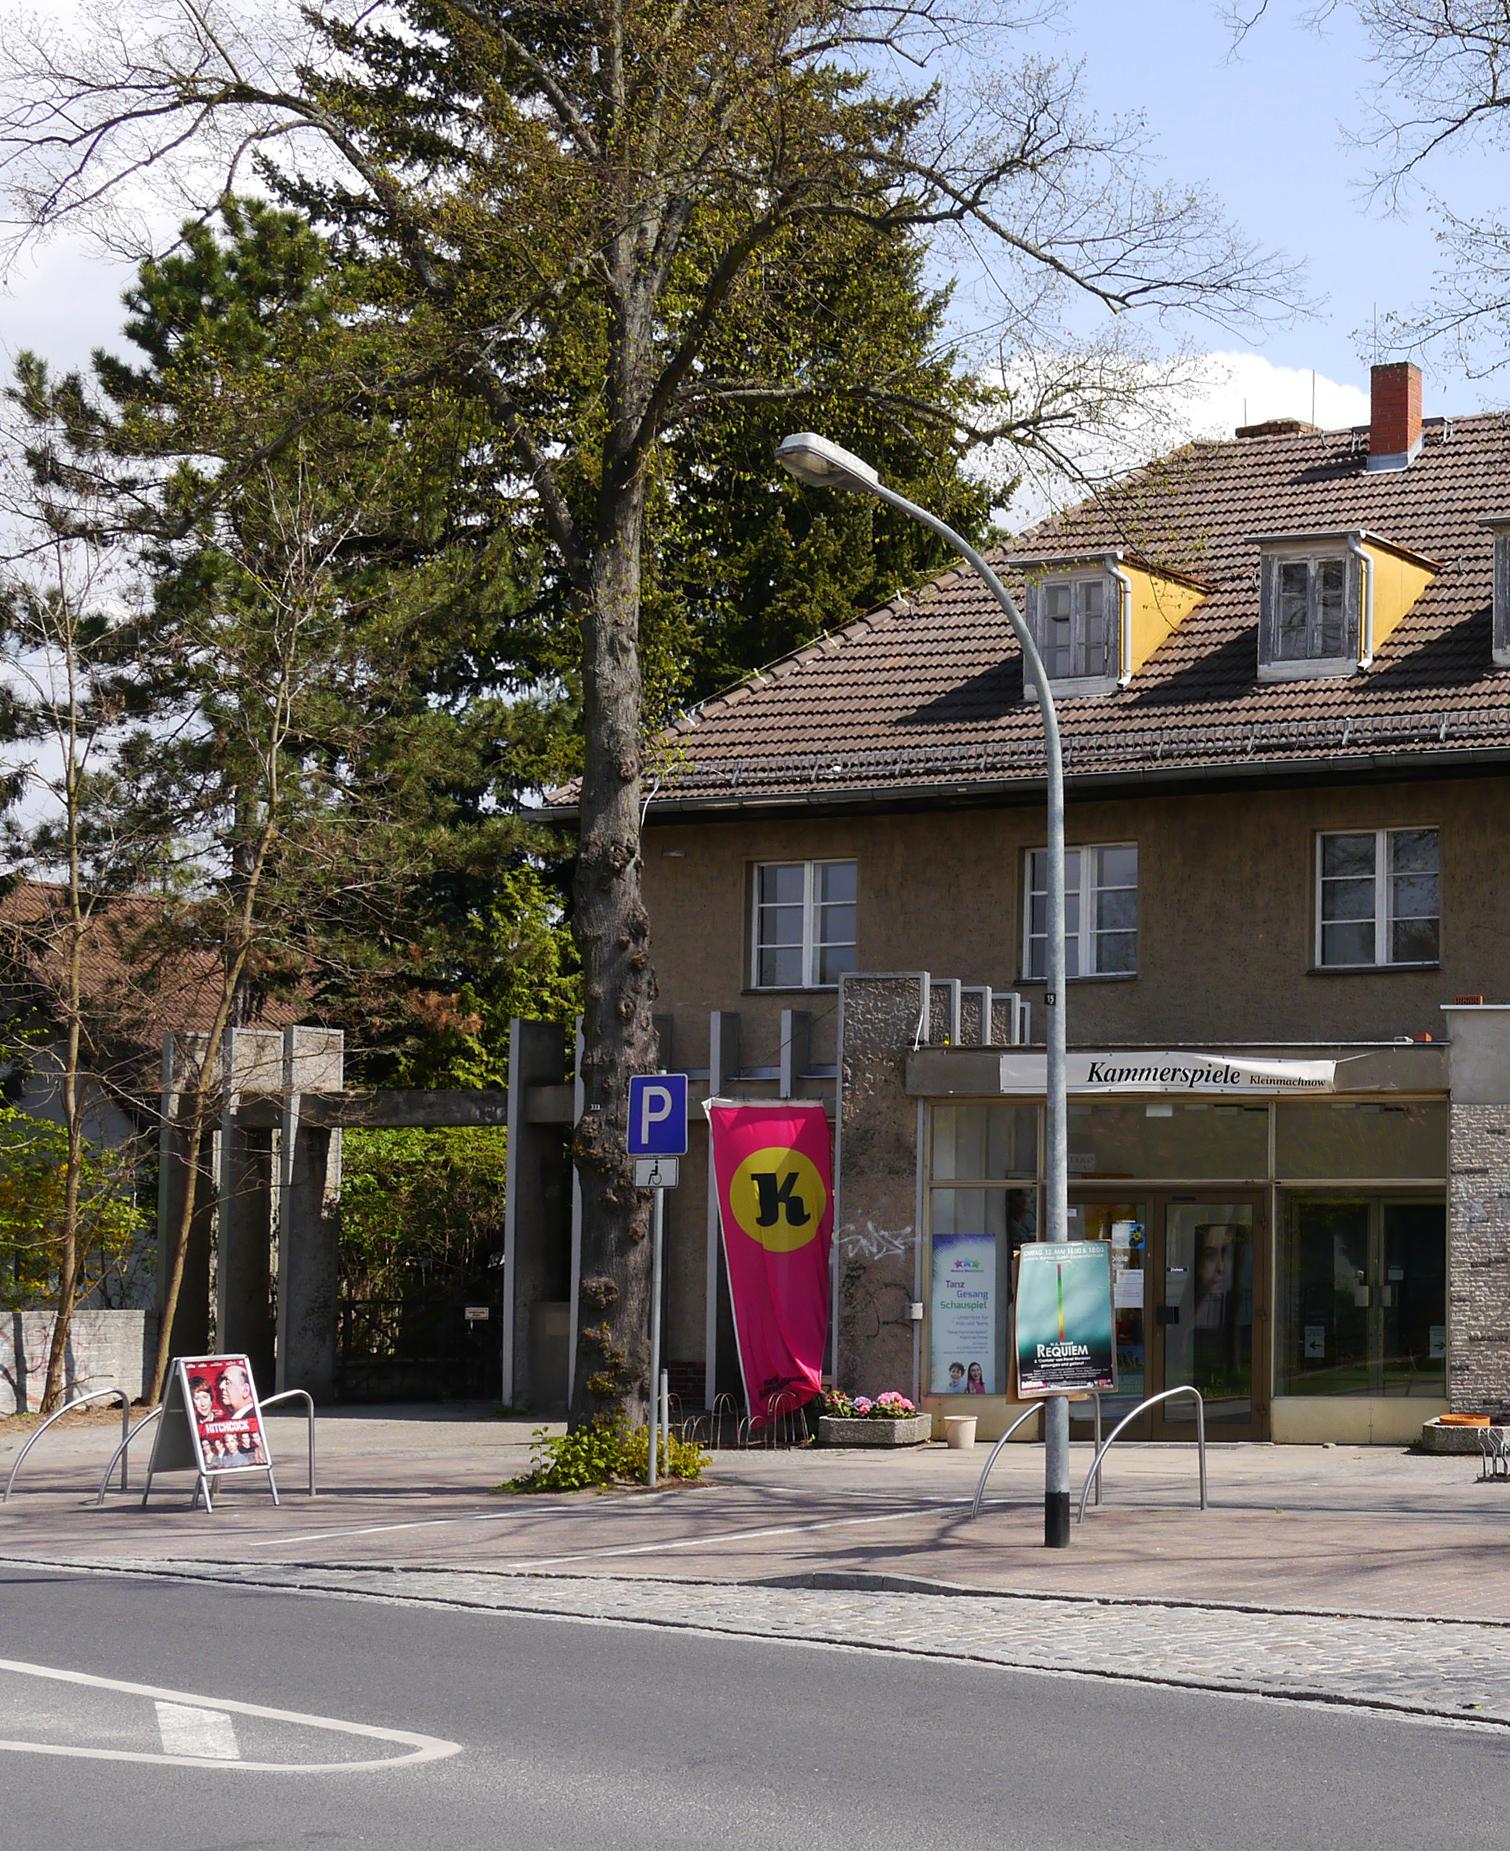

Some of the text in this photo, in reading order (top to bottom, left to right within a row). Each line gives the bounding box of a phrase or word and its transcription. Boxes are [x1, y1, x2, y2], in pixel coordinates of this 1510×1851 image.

[1087, 1061, 1326, 1087] Kammerspiele Kleinmachnow
[641, 1086, 672, 1144] P
[751, 1172, 811, 1227] K
[945, 1280, 965, 1289] Tanz
[956, 1290, 989, 1300] Gesang
[940, 1300, 987, 1311] Schauspiel
[1037, 1344, 1088, 1358] REQUIEM
[206, 1421, 249, 1433] HITCHCOCK
